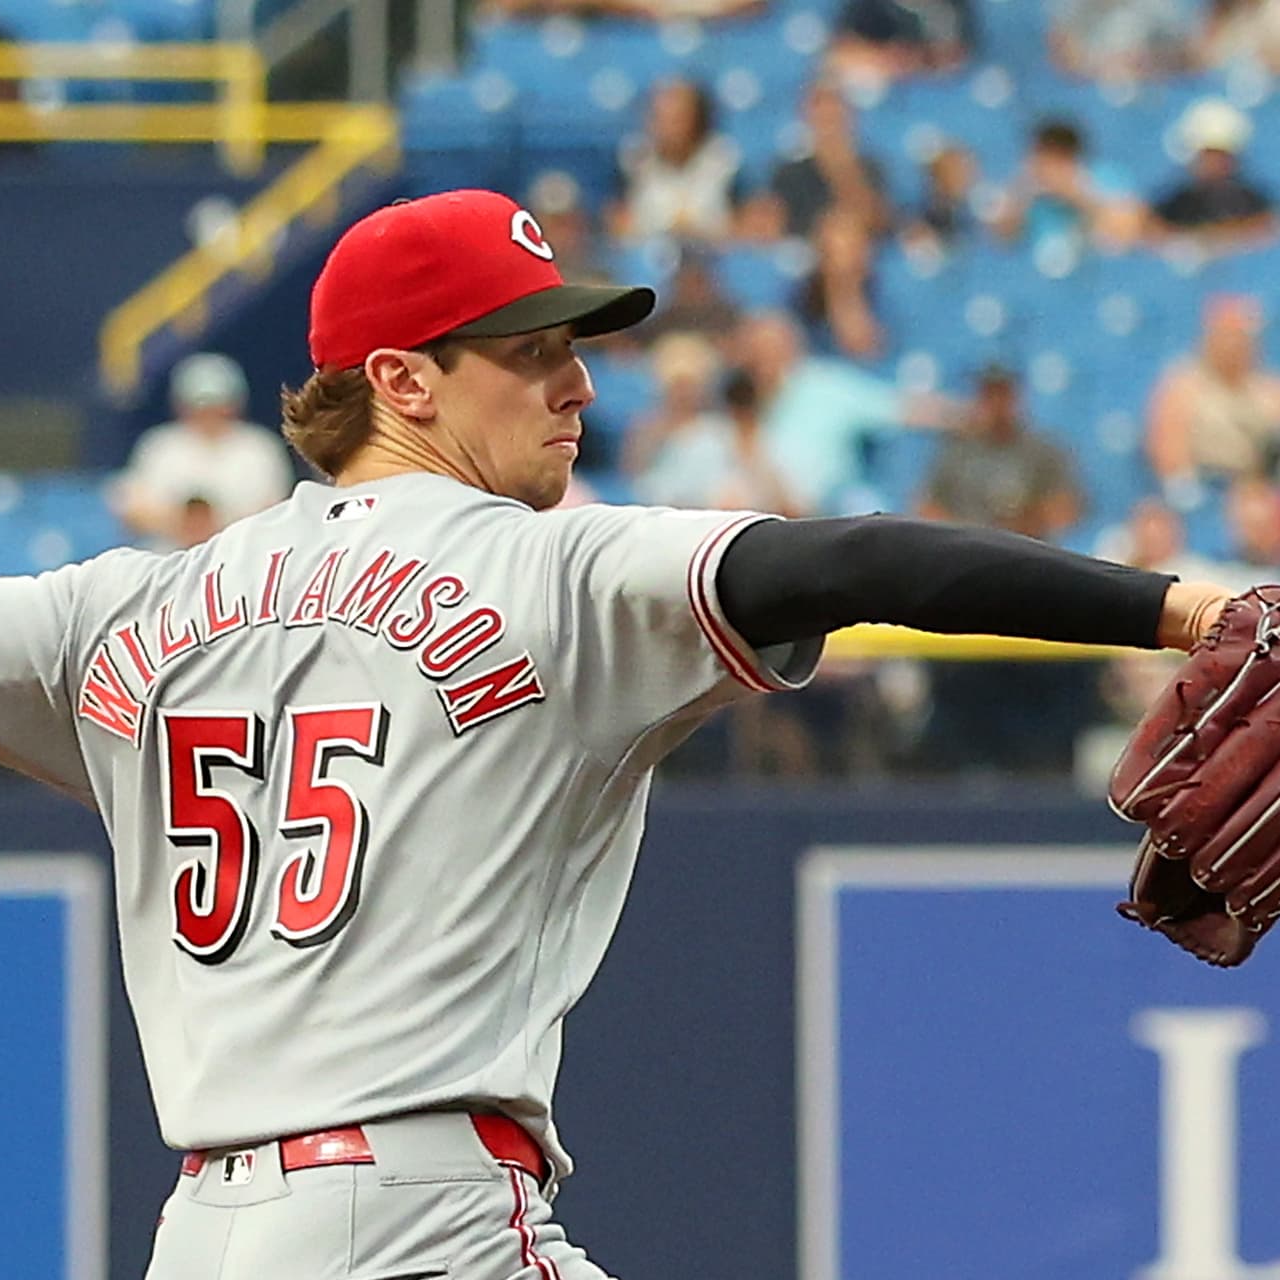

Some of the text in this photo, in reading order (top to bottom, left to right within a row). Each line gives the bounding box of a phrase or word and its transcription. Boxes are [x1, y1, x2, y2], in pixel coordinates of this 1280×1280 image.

[510, 208, 554, 261] C
[79, 546, 545, 748] WILLIAMSON
[158, 700, 391, 966] 55
